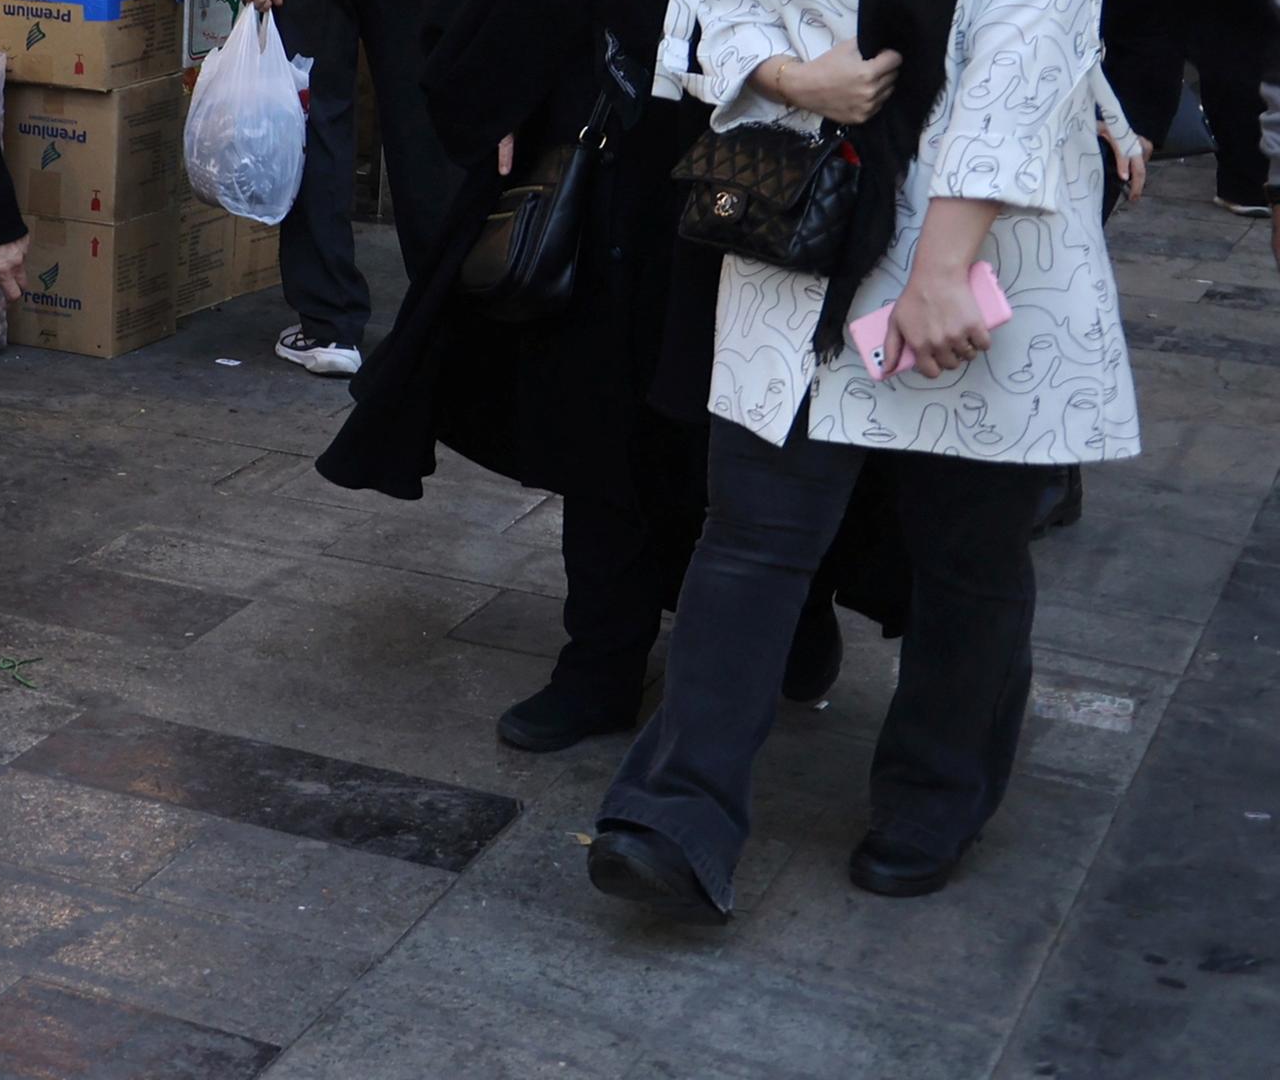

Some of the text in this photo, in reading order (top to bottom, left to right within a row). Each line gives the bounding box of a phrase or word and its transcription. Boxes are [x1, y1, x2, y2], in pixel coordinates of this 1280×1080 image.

[2, 3, 73, 24] Premium
[18, 122, 88, 145] Premium
[22, 289, 83, 312] remium
